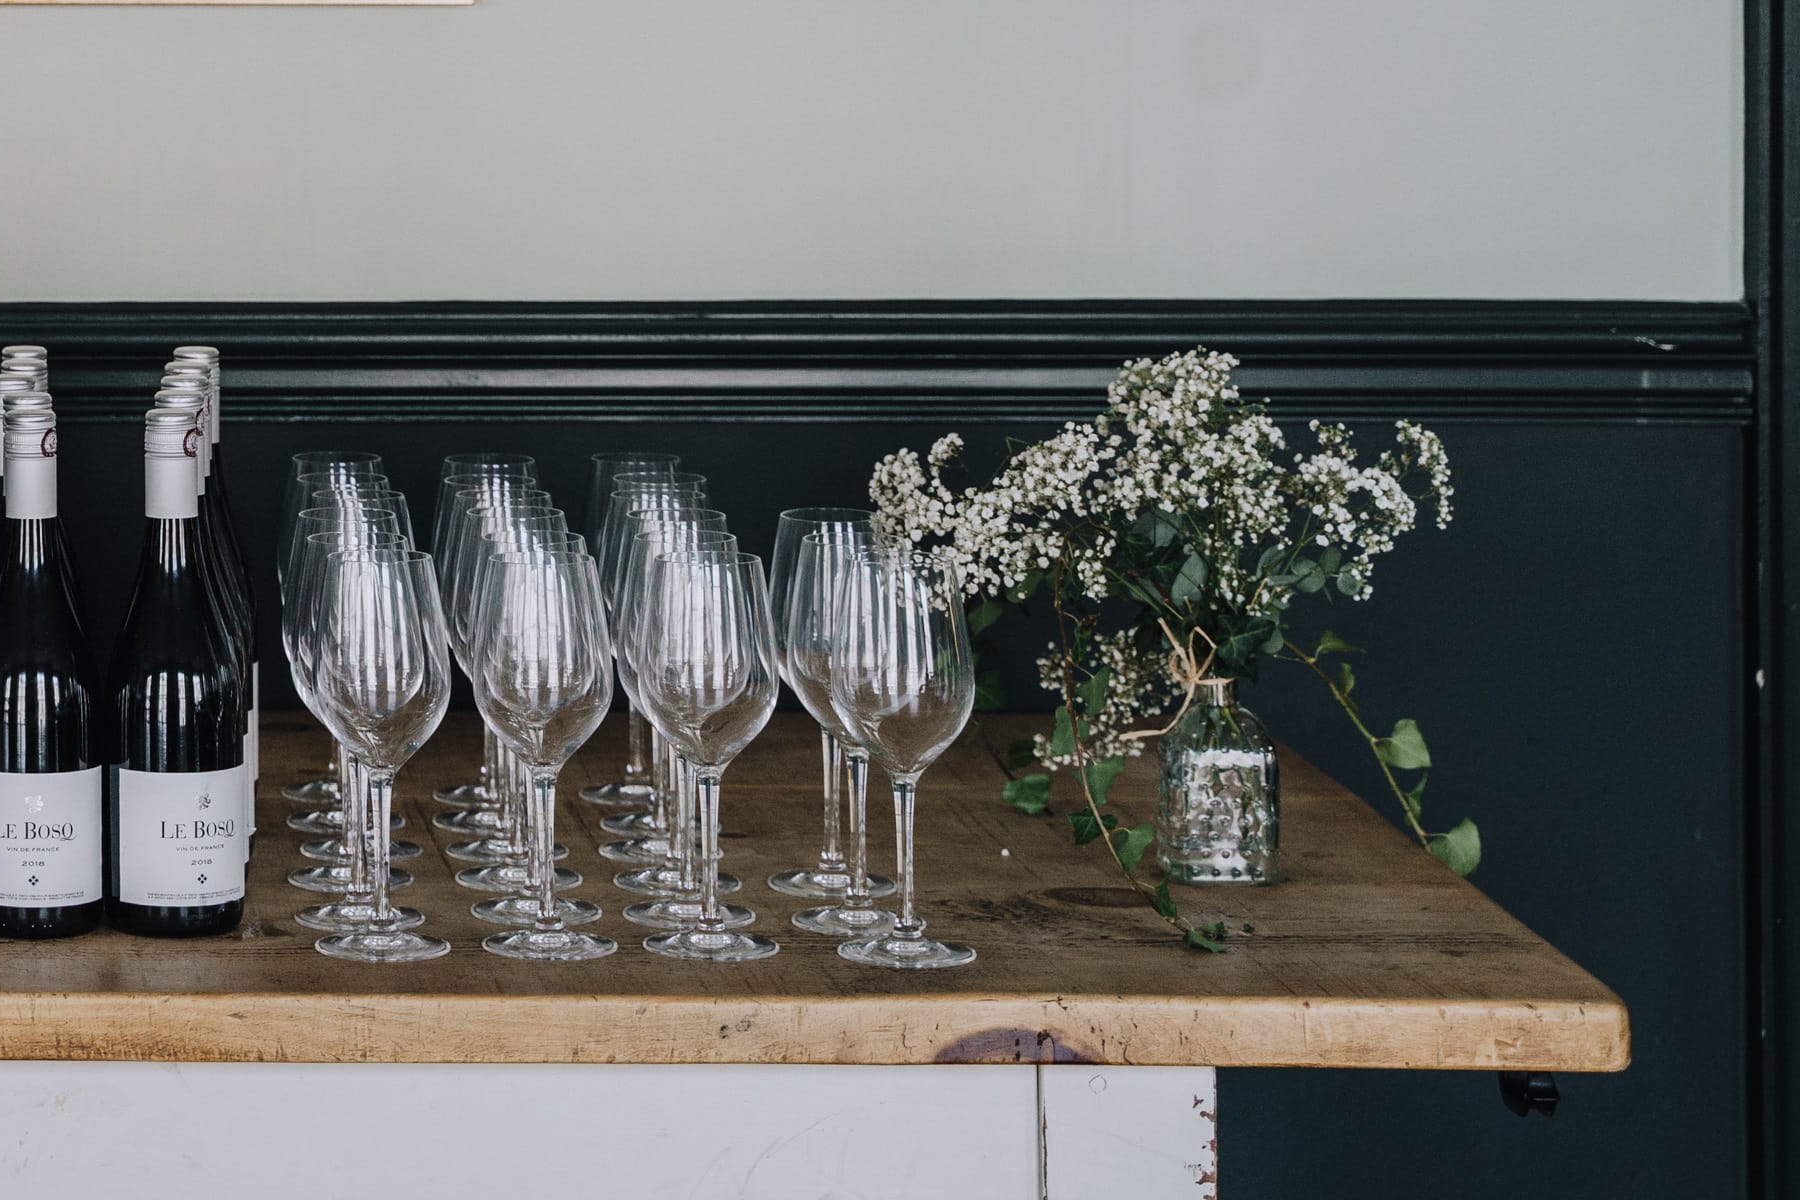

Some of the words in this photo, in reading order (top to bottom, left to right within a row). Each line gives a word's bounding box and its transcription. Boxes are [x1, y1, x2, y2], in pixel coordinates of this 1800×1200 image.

[23, 821, 78, 841] BOSQ
[160, 820, 187, 839] LE
[193, 819, 235, 839] BOSQ
[200, 843, 225, 851] FRANCE
[191, 858, 213, 866] 2018
